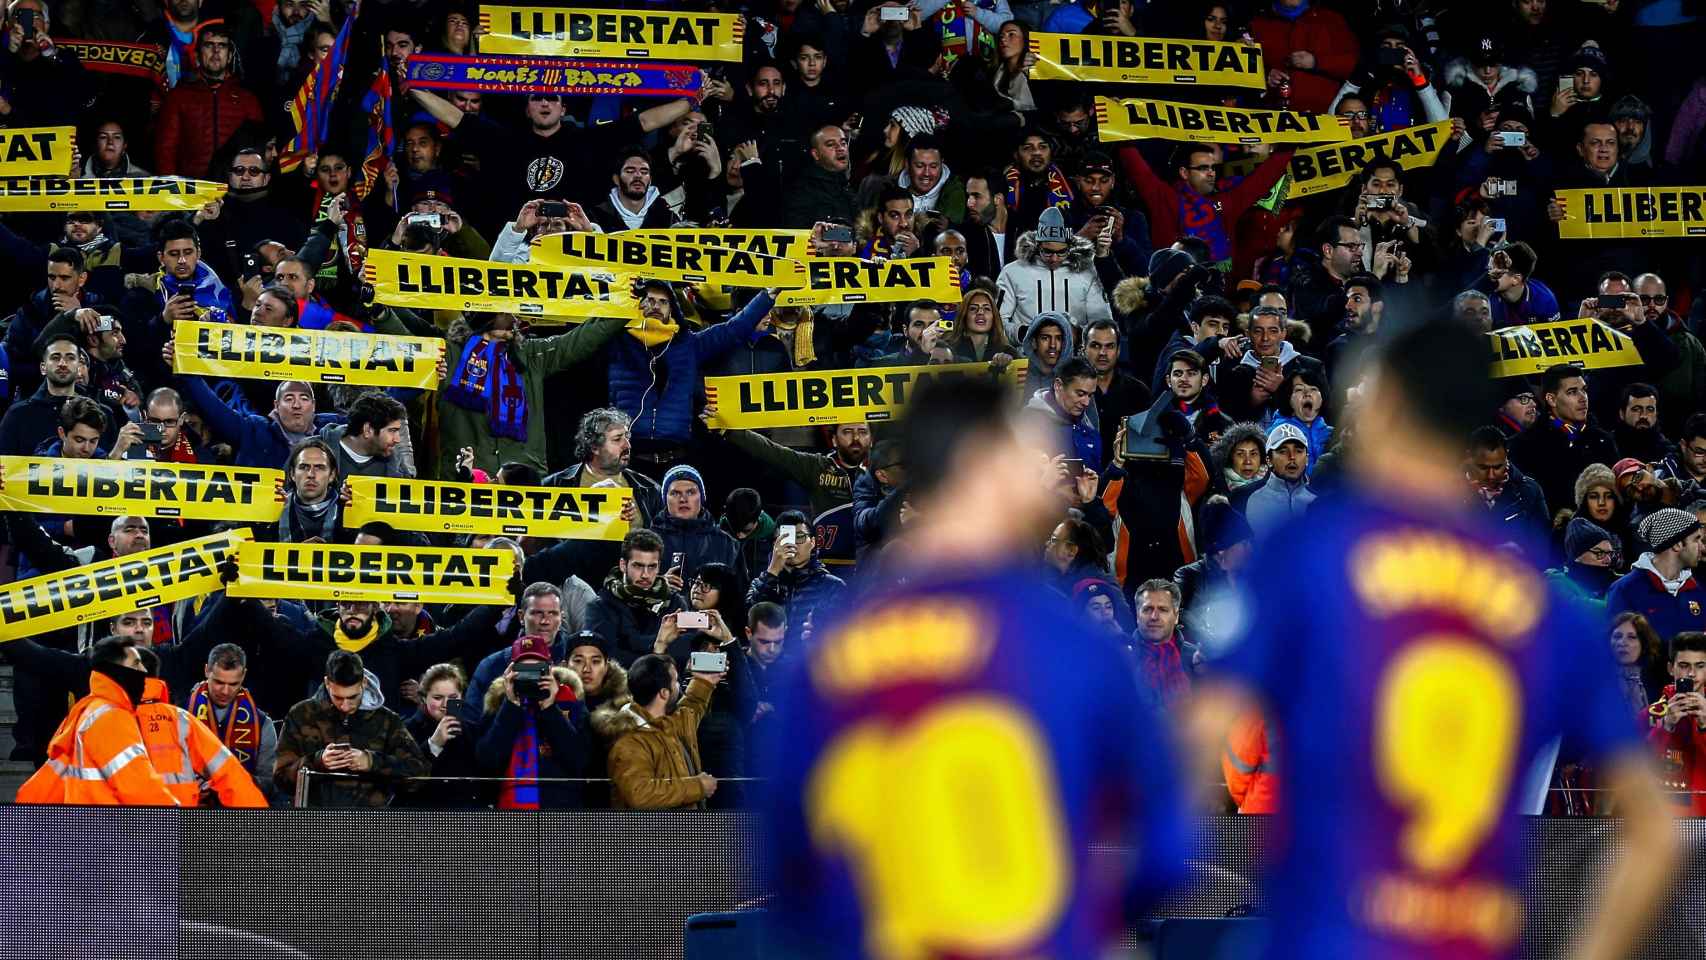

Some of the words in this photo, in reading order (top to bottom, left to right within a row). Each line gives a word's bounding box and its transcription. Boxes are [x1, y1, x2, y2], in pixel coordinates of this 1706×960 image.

[511, 12, 720, 46] LLIBERTAT
[1060, 39, 1262, 74] LLIBERTAT
[1127, 102, 1322, 134] LLIBERTAT
[1584, 192, 1706, 223] LLIBER
[562, 233, 776, 277] LLIBERTAT
[397, 264, 611, 302] LLIBERTAT
[198, 327, 422, 373] LLIBERTAT
[28, 462, 261, 505] LLIBERTAT
[375, 483, 607, 523] LLIBERTAT
[0, 539, 230, 625] LLIBERTAT
[263, 549, 499, 588] LLIBERTAT
